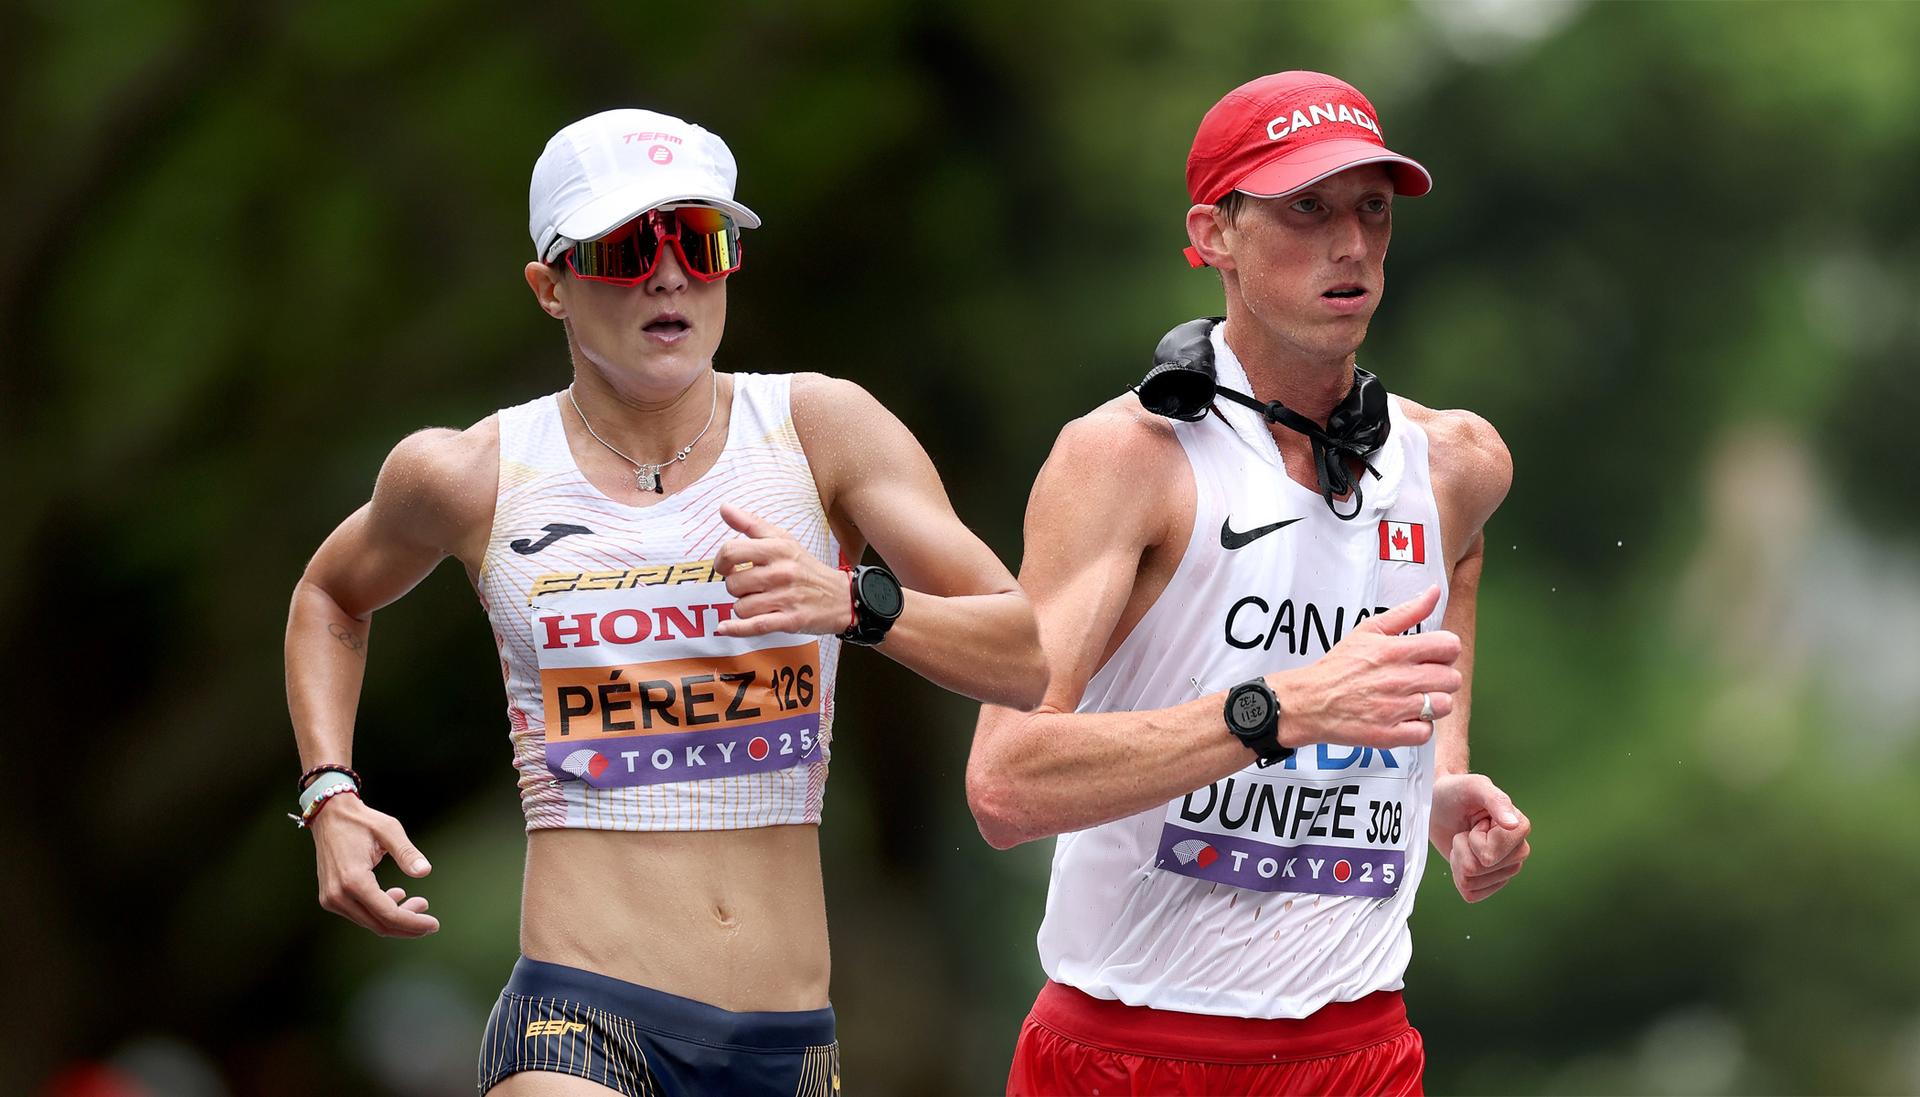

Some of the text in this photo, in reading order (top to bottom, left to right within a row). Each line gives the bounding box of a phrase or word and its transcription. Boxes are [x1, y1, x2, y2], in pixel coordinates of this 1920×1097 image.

[539, 602, 735, 649] HON
[557, 664, 814, 736] PÉREZ 126
[1180, 778, 1402, 844] DUNFEE 308
[526, 1020, 586, 1037] ESP
